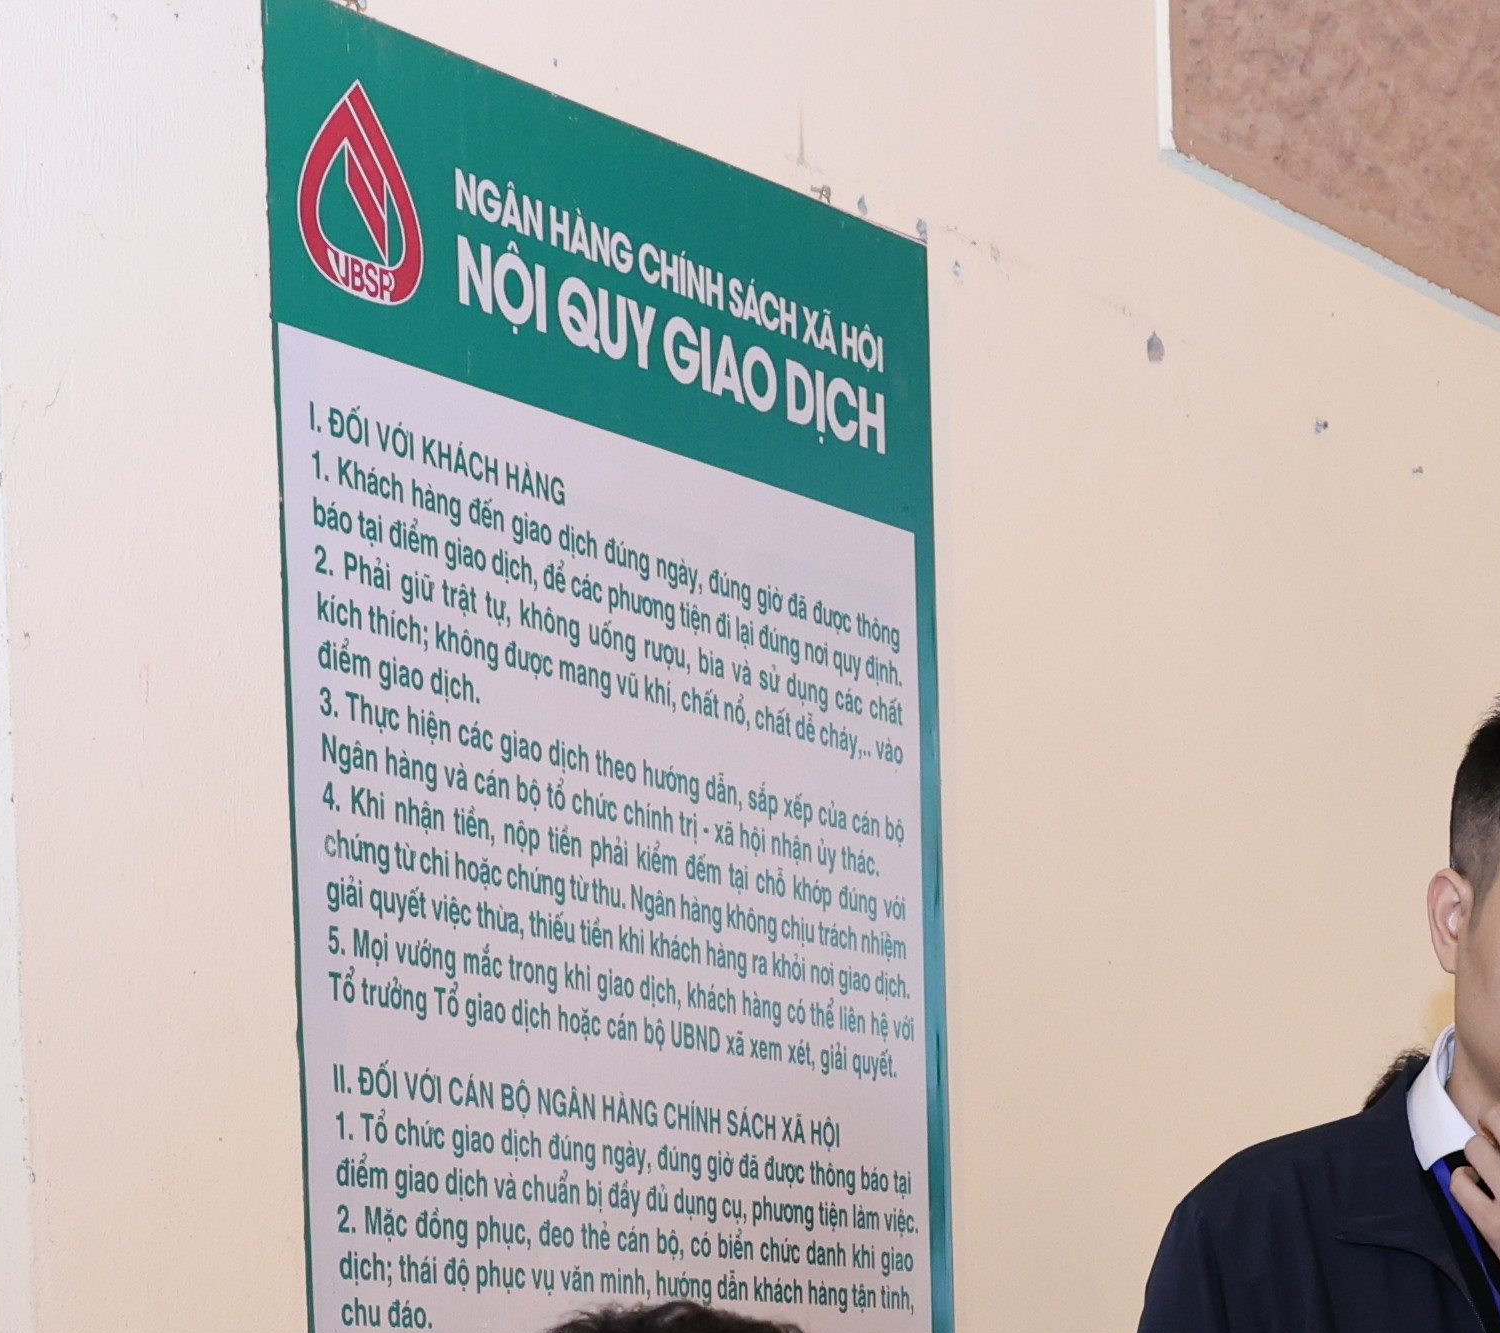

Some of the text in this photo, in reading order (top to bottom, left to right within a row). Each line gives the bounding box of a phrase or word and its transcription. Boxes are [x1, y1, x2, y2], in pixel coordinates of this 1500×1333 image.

[455, 167, 884, 373] NGÂN HÀNG CHÍNH SÁCH XÃ HỘI
[457, 234, 886, 455] NỘI QUY GIAO DỊCH
[309, 400, 566, 506] I. ĐỐI VỚI KHÁCH HÀNG
[311, 450, 900, 655] 1. Khách hàng đến giao dịch đúng ngày, đúng giờ đã được thông
[333, 1059, 840, 1153] II. ĐỐI VỚI CÁN BỘ NGÂN HÀNG CHÍNH SÁCH XÃ HỘI
[341, 1297, 433, 1329] chu đáo.
